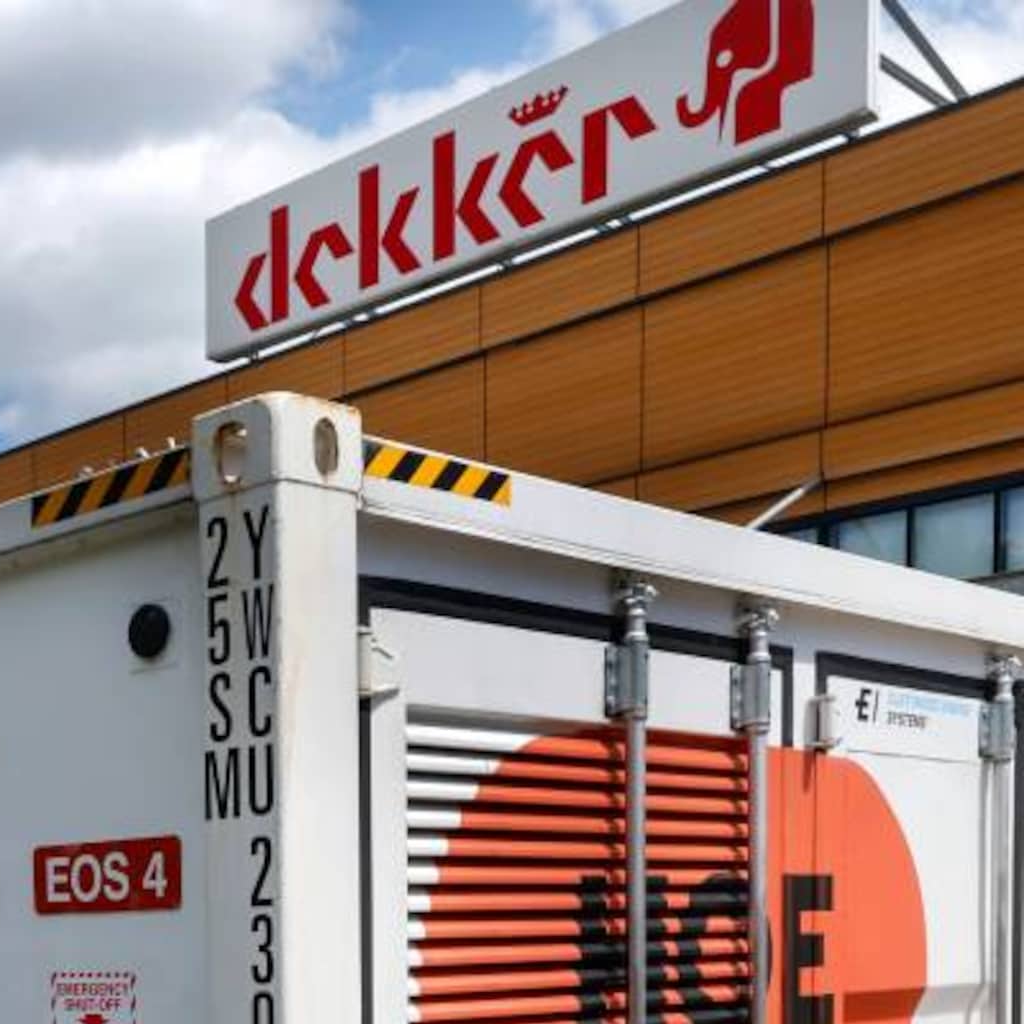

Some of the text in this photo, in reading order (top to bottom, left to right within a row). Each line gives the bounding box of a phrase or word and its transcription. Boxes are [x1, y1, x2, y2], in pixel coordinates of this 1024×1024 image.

[234, 95, 656, 331] dekker
[44, 851, 167, 902] EOS 4
